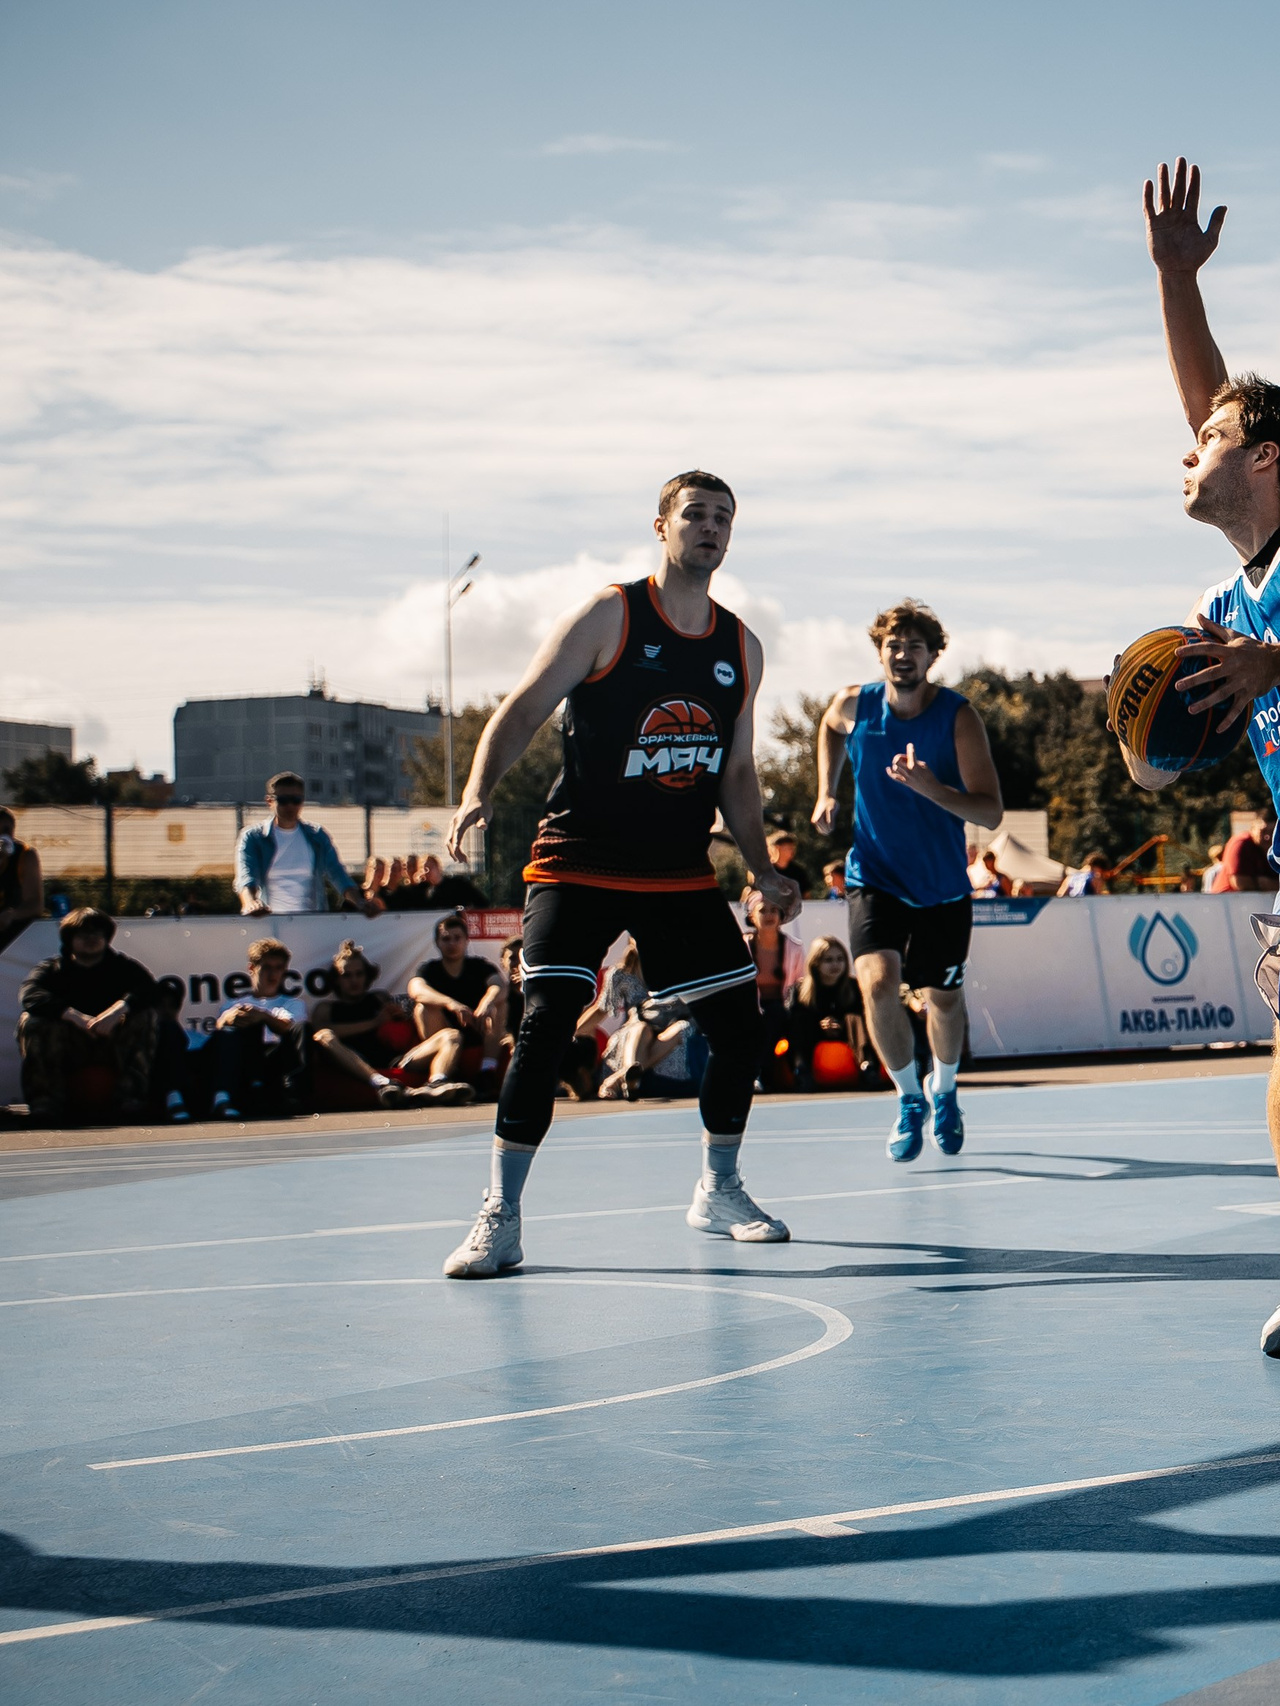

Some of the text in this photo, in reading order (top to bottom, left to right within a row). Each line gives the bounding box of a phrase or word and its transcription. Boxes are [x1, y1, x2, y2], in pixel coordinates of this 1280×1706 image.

[1117, 662, 1164, 747] Wilso
[638, 732, 719, 745] ОРАНЖЕВЫЙ
[624, 746, 723, 778] МЯЧ
[1120, 1001, 1235, 1035] АКВА-ЛАЙФ
